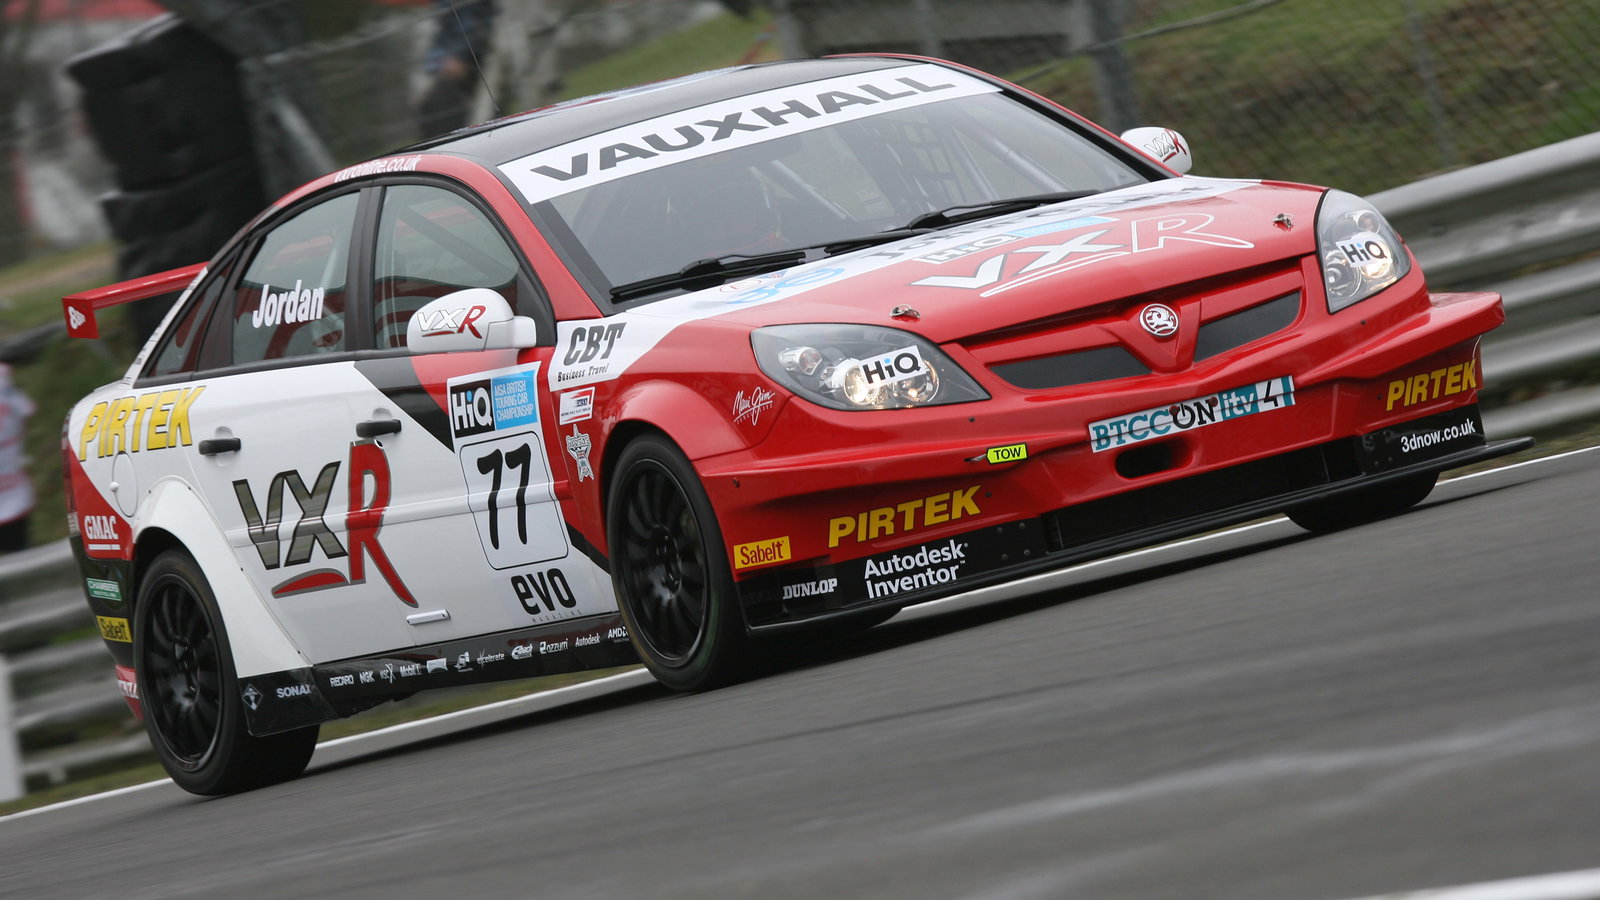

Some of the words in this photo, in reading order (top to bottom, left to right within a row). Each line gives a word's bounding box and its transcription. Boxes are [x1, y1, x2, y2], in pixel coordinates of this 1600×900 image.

[530, 76, 956, 182] VAUXHALL
[1144, 128, 1188, 159] VXR
[905, 213, 1255, 290] VXR
[1340, 240, 1388, 263] HiQ
[252, 279, 324, 328] Jordan
[417, 304, 487, 340] VXR
[563, 322, 627, 366] CBT
[557, 369, 586, 382] Business
[588, 363, 610, 376] Travel
[862, 352, 921, 385] HiQ
[1386, 359, 1477, 411] PIRTEK
[495, 394, 517, 410] TOURING
[517, 391, 529, 405] CAR
[507, 380, 527, 395] BRITISH
[1263, 380, 1279, 408] 4
[79, 385, 207, 462] PIRTEK
[451, 386, 493, 431] HiQ
[496, 403, 534, 422] CHAMPIONSHIP
[1400, 418, 1476, 453] 3dnow.co.uk
[993, 446, 1022, 461] TOW
[477, 443, 531, 550] 77
[84, 515, 119, 540] GMAC
[232, 437, 419, 609] VXR
[827, 484, 983, 549] PIRTEK
[739, 540, 785, 567] Sabelt
[864, 539, 966, 580] Autodesk
[510, 568, 577, 616] evo
[782, 577, 838, 600] DUNLOP
[866, 564, 960, 599] Inventor
[100, 617, 129, 642] Sabelt
[532, 609, 584, 622] MAGAZINE
[276, 684, 312, 698] SONAX
[330, 674, 354, 687] RECARO
[359, 669, 375, 684] NGK
[575, 632, 601, 648] Autodesk
[607, 628, 622, 639] AMD
